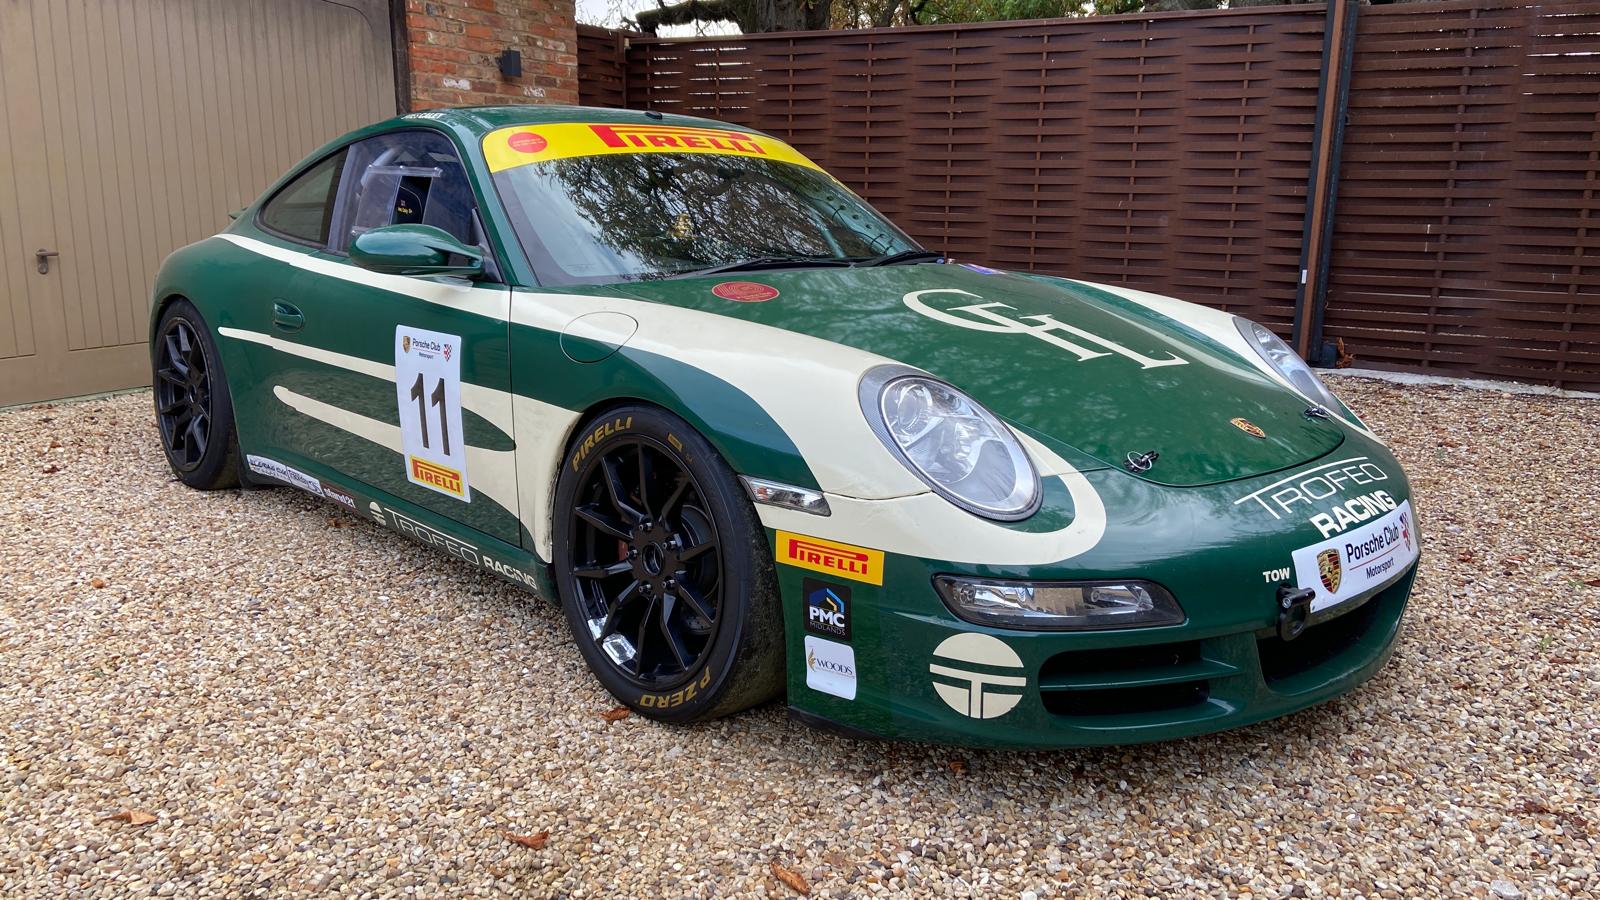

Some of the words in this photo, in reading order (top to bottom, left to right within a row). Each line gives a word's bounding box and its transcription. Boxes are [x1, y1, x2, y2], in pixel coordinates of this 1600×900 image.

[588, 125, 767, 155] PIRELLI
[413, 337, 430, 350] Porsche
[431, 341, 441, 352] Club
[410, 373, 450, 456] 11
[571, 416, 633, 473] PIRELLI
[412, 458, 462, 493] PIRELLI
[1234, 457, 1388, 519] TROFEO
[1309, 490, 1398, 539] RACING
[384, 507, 480, 565] TROFEO
[482, 555, 538, 590] RACING
[788, 538, 869, 575] PIRELLI
[1345, 533, 1384, 563] Porsche
[1384, 523, 1400, 546] Club
[1263, 567, 1290, 583] TOW
[1366, 556, 1394, 580] Motorsport
[809, 606, 845, 628] PMC
[809, 621, 846, 636] MIDLANDS
[696, 665, 711, 690] P
[817, 658, 853, 675] WOODS
[640, 687, 703, 709] ZERO
